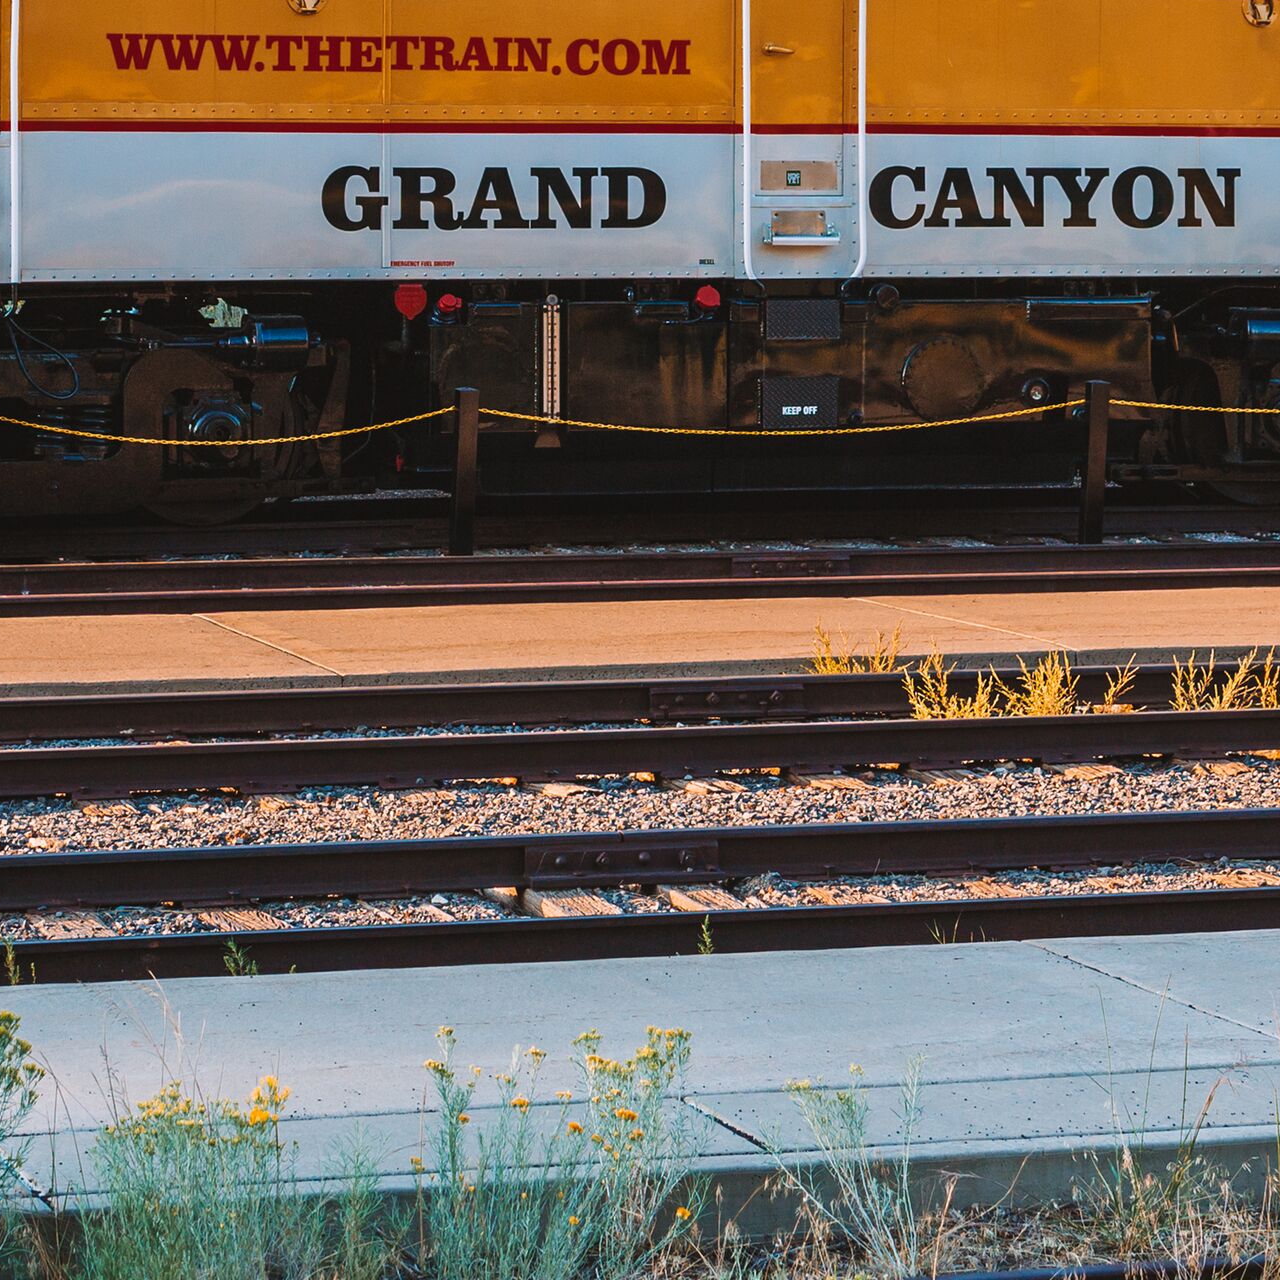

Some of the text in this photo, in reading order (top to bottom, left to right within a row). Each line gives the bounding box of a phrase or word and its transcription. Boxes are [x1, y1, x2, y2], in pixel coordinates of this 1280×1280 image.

[106, 33, 692, 76] WWW.THETRAIN.COM
[321, 165, 1242, 232] GRAND CANYON
[782, 405, 818, 415] KEEP OFF
